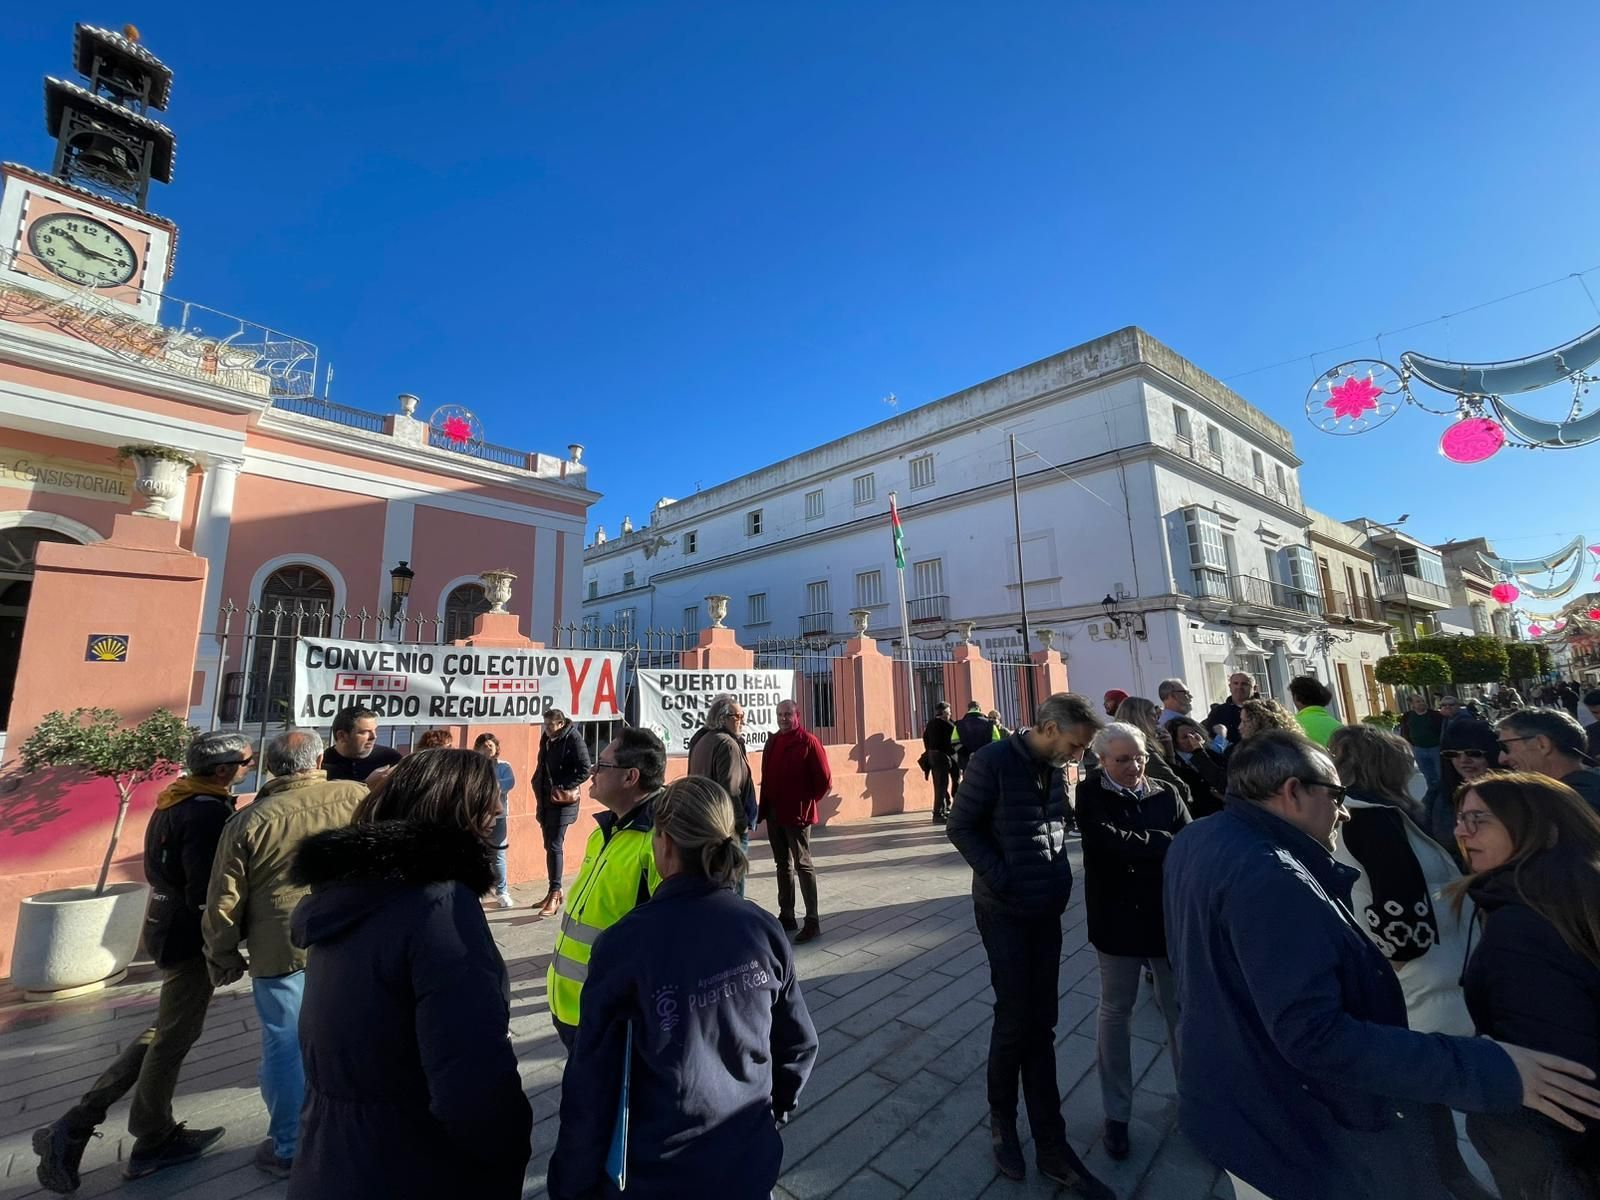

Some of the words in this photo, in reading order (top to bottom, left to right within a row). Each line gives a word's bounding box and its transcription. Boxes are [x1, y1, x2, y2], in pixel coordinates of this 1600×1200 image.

[49, 226, 65, 237] 10
[67, 222, 78, 232] 11
[83, 225, 98, 236] 12
[44, 235, 52, 243] 9
[105, 235, 110, 243] 1
[47, 248, 56, 256] 8
[114, 248, 123, 256] 2
[77, 270, 86, 279] 6
[111, 268, 118, 276] 4
[306, 645, 434, 675] CONVENIO
[443, 654, 560, 677] COLECTIVO
[440, 677, 456, 694] Y
[563, 657, 619, 716] YA
[660, 674, 737, 692] PUERTO
[743, 674, 781, 690] REAL
[429, 695, 554, 718] REGULADOR
[661, 694, 698, 711] CON
[704, 694, 718, 709] E
[749, 960, 759, 970] de
[688, 980, 738, 1013] Puerto
